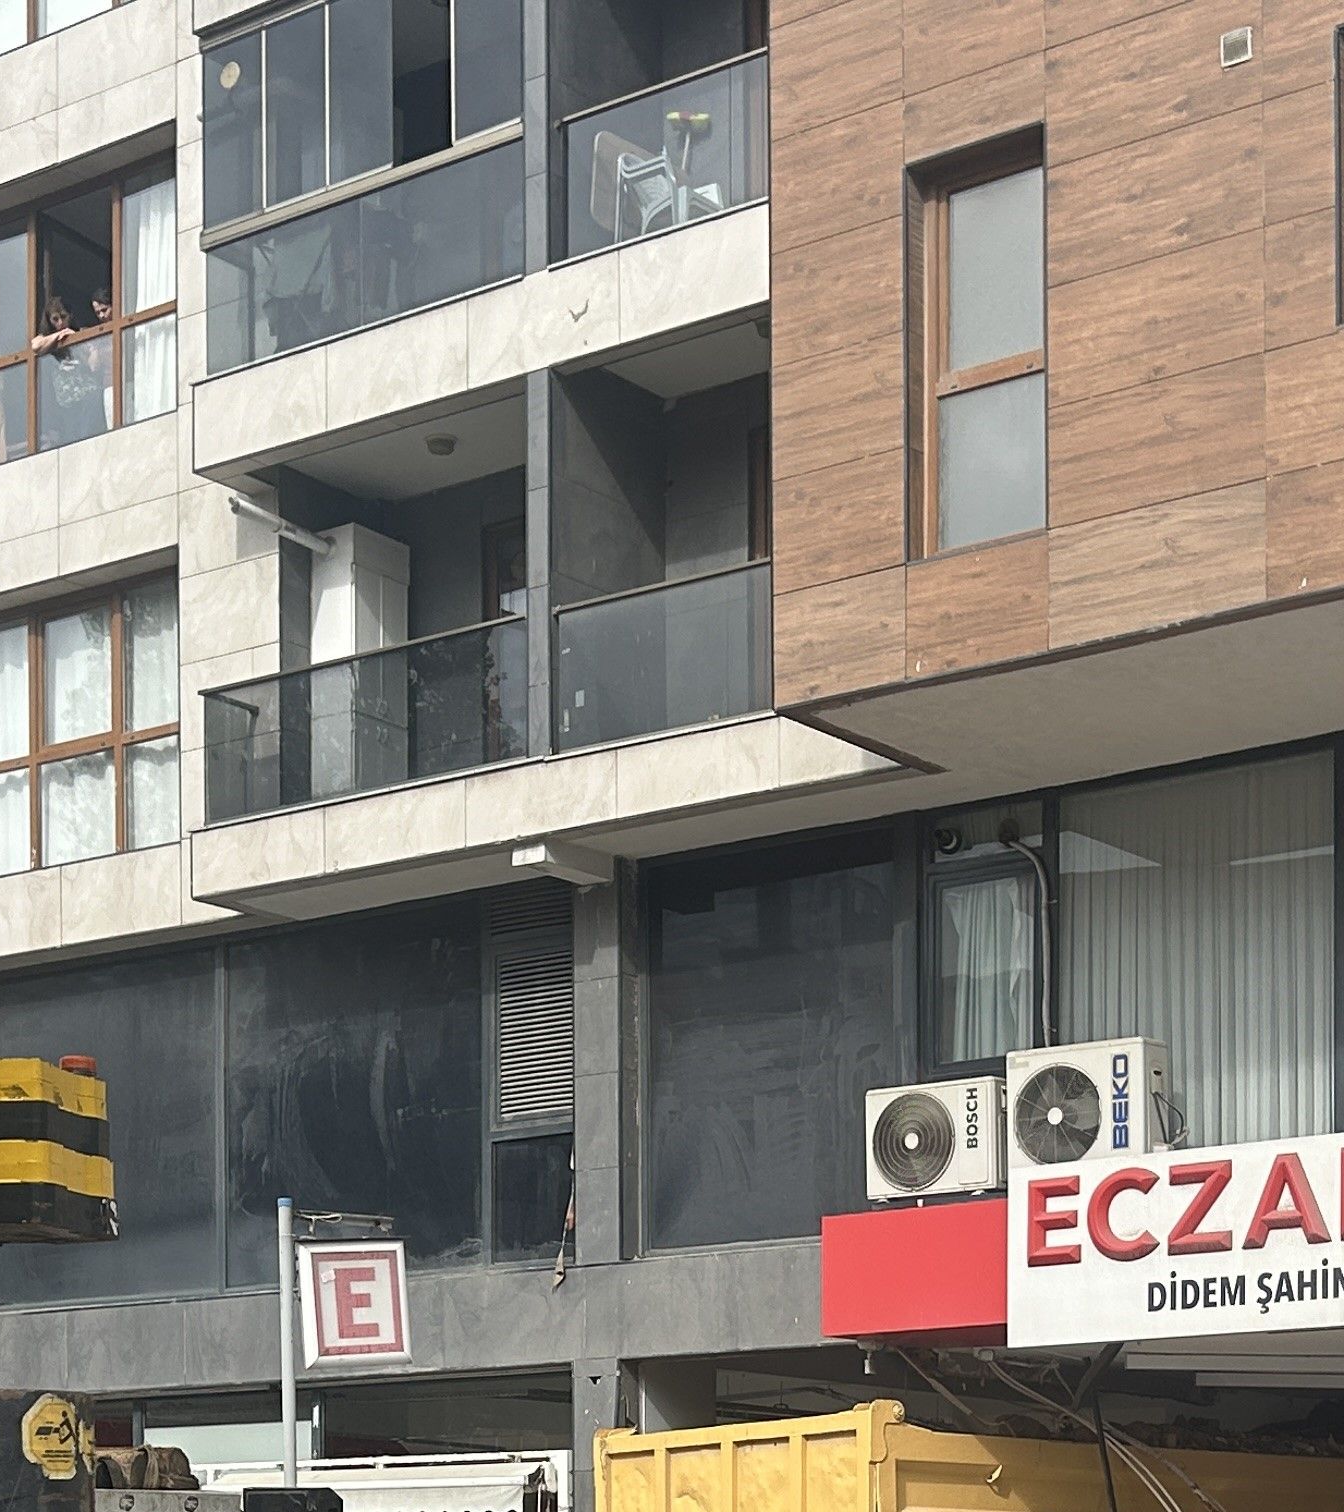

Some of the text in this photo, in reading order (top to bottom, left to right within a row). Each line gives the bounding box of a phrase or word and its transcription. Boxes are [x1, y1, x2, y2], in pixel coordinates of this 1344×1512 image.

[966, 1086, 978, 1149] BOSCH
[1112, 1053, 1129, 1149] BEKO
[334, 1265, 381, 1340] E
[1146, 1271, 1248, 1314] DİDEM
